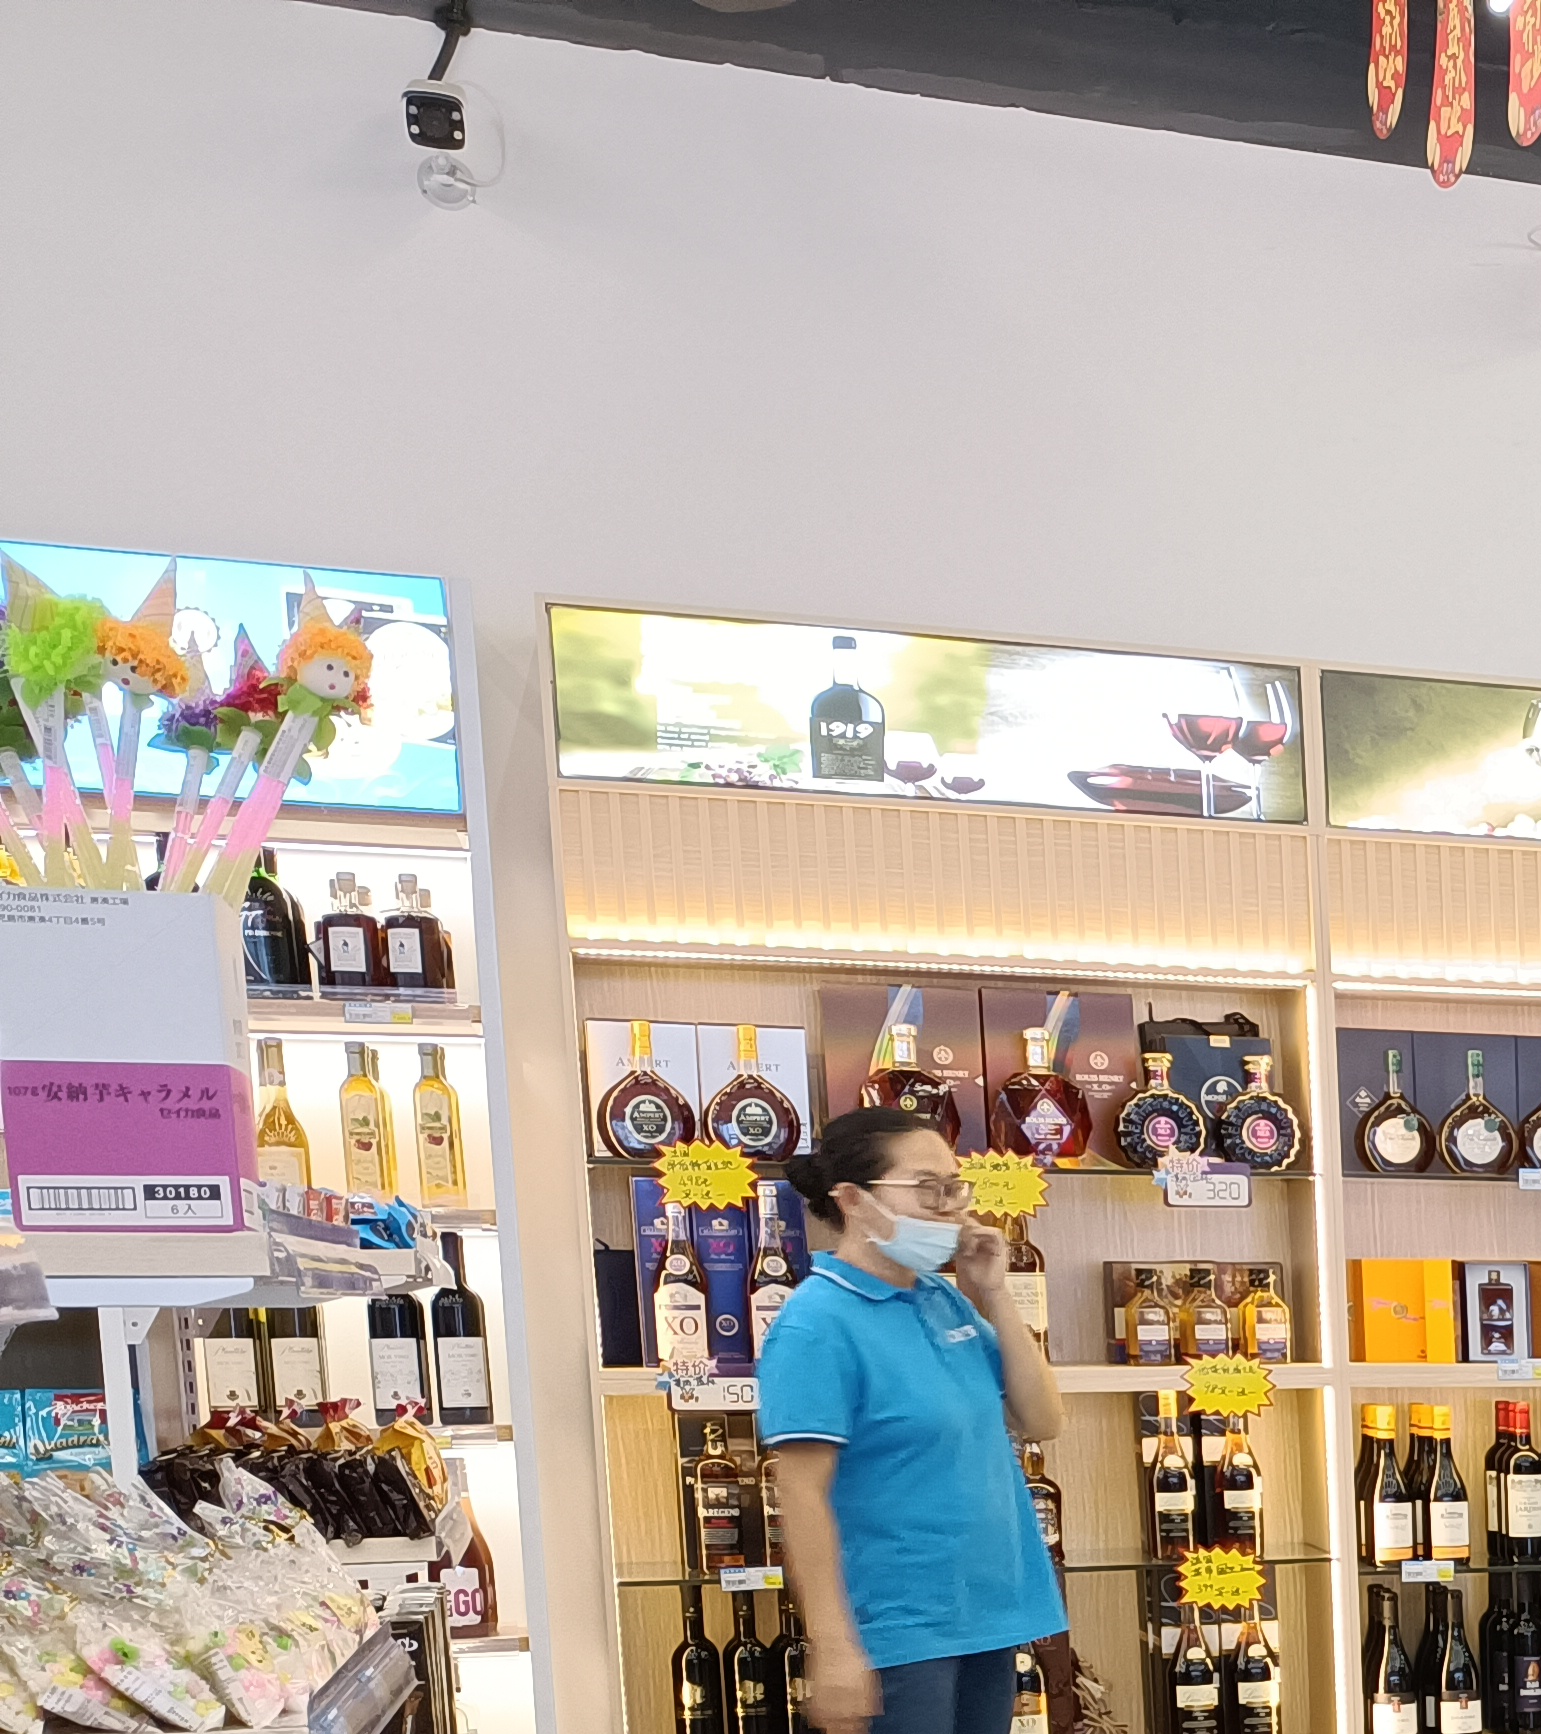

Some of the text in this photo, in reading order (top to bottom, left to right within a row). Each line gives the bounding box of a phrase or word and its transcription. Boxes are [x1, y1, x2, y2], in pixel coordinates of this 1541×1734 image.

[820, 721, 873, 738] 1919
[42, 1081, 219, 1104] 安納芋キャラメル
[158, 1106, 222, 1121] セイカ食品
[1169, 1158, 1202, 1173] 特价
[154, 1186, 211, 1199] 30180
[1206, 1180, 1241, 1200] 320
[170, 1202, 198, 1217] 6入
[664, 1315, 700, 1336] XO
[673, 1359, 709, 1377] 特价
[723, 1384, 754, 1404] 150
[1017, 1716, 1037, 1728] XO
